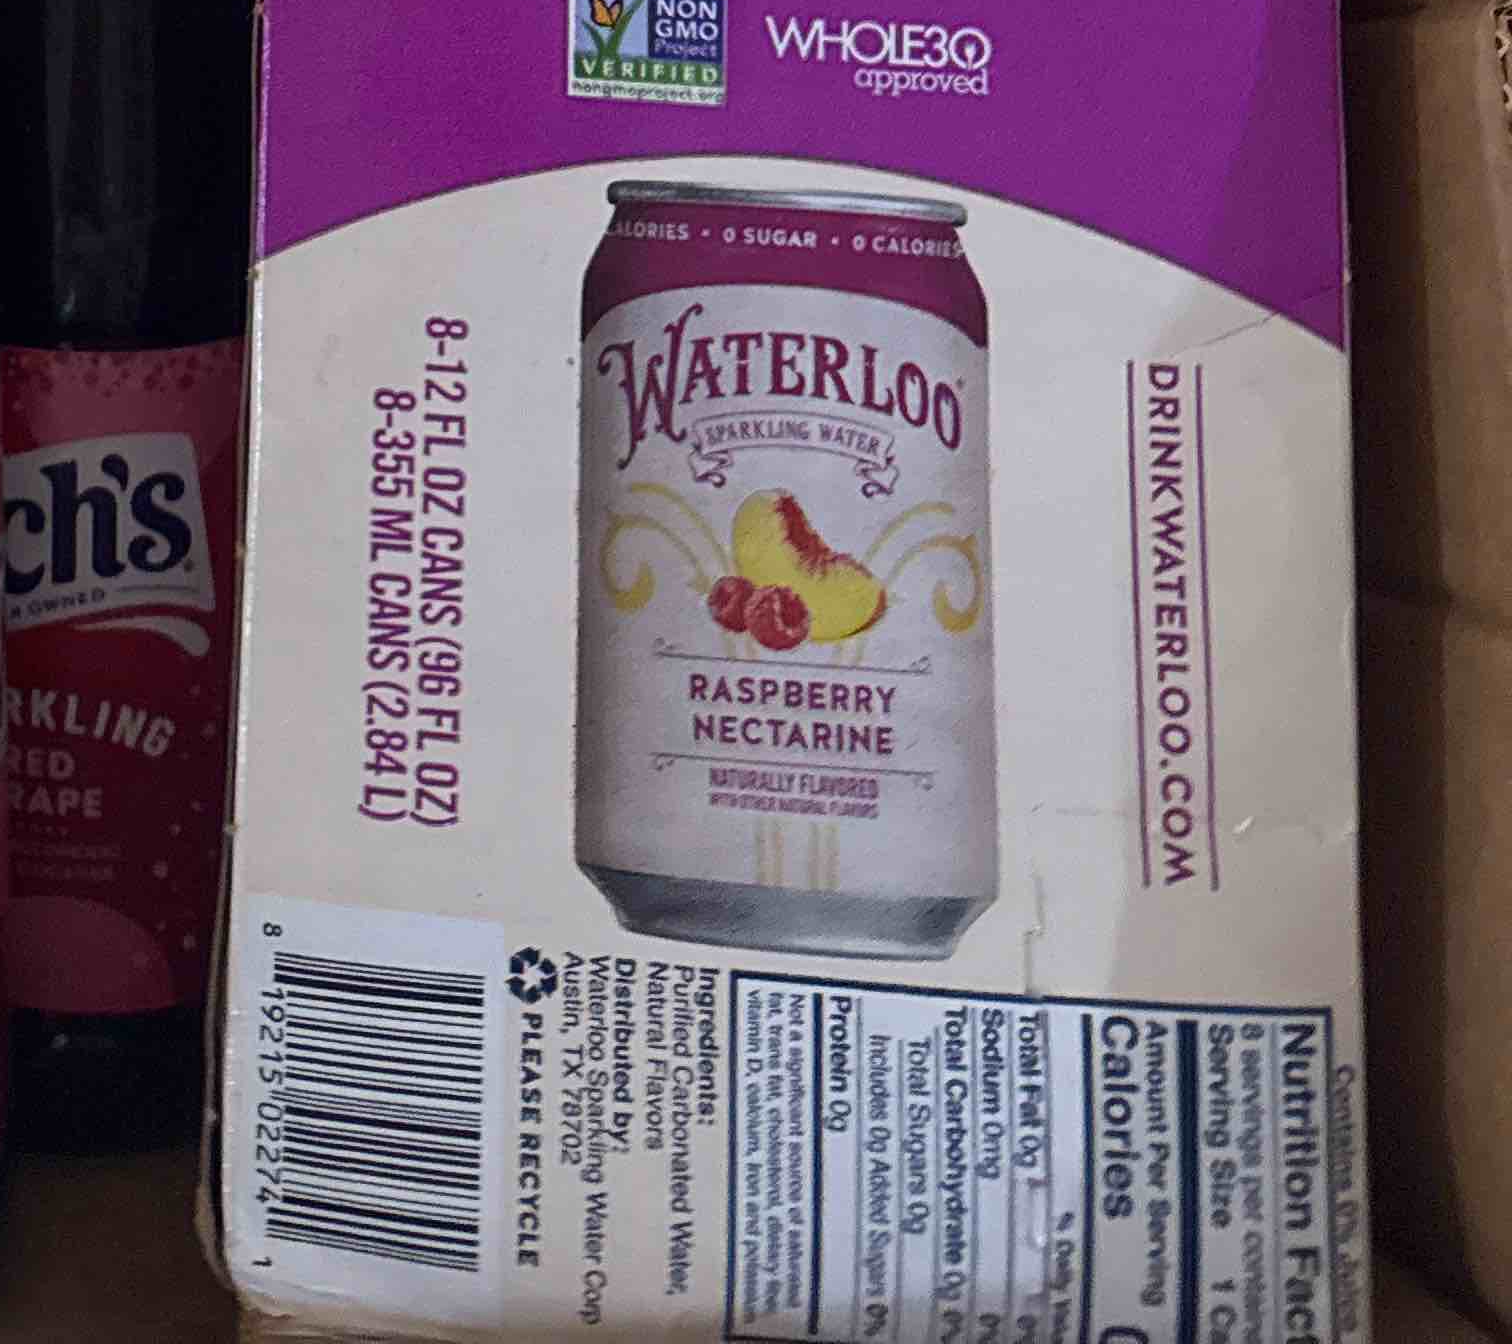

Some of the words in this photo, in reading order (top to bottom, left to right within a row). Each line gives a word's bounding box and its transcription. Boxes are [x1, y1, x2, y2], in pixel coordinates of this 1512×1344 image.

[654, 39, 718, 60] Project
[655, 20, 719, 43] GMO
[764, 15, 993, 72] WHOLE30
[580, 59, 719, 83] VERIFIED
[853, 67, 989, 98] approved
[743, 227, 818, 249] SUGAR
[872, 235, 965, 259] CALORIES
[423, 314, 469, 404] 8-12
[596, 303, 962, 471] WATERLOO
[370, 386, 418, 499] 8-355
[421, 411, 468, 457] FL
[705, 421, 809, 446] SPARKLING
[819, 423, 882, 456] WATER
[4, 453, 192, 594] ch's
[421, 467, 467, 516] OZ
[368, 508, 414, 563] ML
[419, 526, 465, 628] CANS
[366, 571, 413, 673] CANS
[1147, 362, 1198, 887] DRINKWATERLOO.COM
[415, 634, 463, 699] (96
[689, 673, 897, 714] RASPBERRY
[8, 687, 176, 758] RKLING
[360, 680, 410, 778] (2.84
[415, 707, 461, 752] FL
[692, 715, 894, 755] NECTARINE
[356, 783, 408, 822] L)
[409, 760, 460, 828] OZ)
[708, 767, 794, 794] NATURALLY
[799, 773, 880, 800] FLAVORED
[559, 950, 585, 1035] Austin,
[587, 955, 611, 1061] Waterloo
[646, 961, 669, 1049] Natural
[671, 964, 694, 1057] Purified
[259, 987, 286, 1086] 19215
[561, 1046, 583, 1078] TX
[612, 957, 636, 1103] Distributed
[695, 967, 720, 1125] Ingredients:
[829, 995, 852, 1092] Protein
[907, 1036, 931, 1096] Total
[943, 1007, 967, 1070] Total
[980, 1008, 1003, 1114] Sodium
[1018, 1011, 1042, 1076] Total
[519, 1012, 544, 1123] PLEASE
[645, 1059, 667, 1150] Flavors
[868, 1034, 891, 1120] Includes
[1144, 1021, 1170, 1133] Amount
[1203, 1023, 1234, 1148] Serving
[560, 1087, 583, 1166] 78702
[579, 1069, 609, 1184] Sparkling
[608, 1111, 634, 1153] by:
[669, 1065, 694, 1213] Carbonated
[821, 1099, 851, 1132] 0g
[1018, 1083, 1042, 1128] Fat
[1101, 1015, 1140, 1219] Calories
[1236, 1048, 1265, 1167] servings
[1281, 1022, 1319, 1231] Nutrition
[254, 1102, 284, 1204] 02274
[900, 1103, 931, 1195] Sugars
[938, 1078, 967, 1265] Carbohydrate
[975, 1121, 1003, 1180] 0mg
[1011, 1134, 1041, 1167] 0g
[1147, 1142, 1170, 1190] Per
[517, 1132, 544, 1268] RECYCLE
[868, 1158, 891, 1223] Added
[900, 1200, 930, 1234] 0g
[1208, 1158, 1236, 1229] Size
[586, 1192, 608, 1264] Water
[665, 1222, 692, 1296] Water,
[1139, 1198, 1172, 1306] Serving
[578, 1270, 606, 1325] Corp
